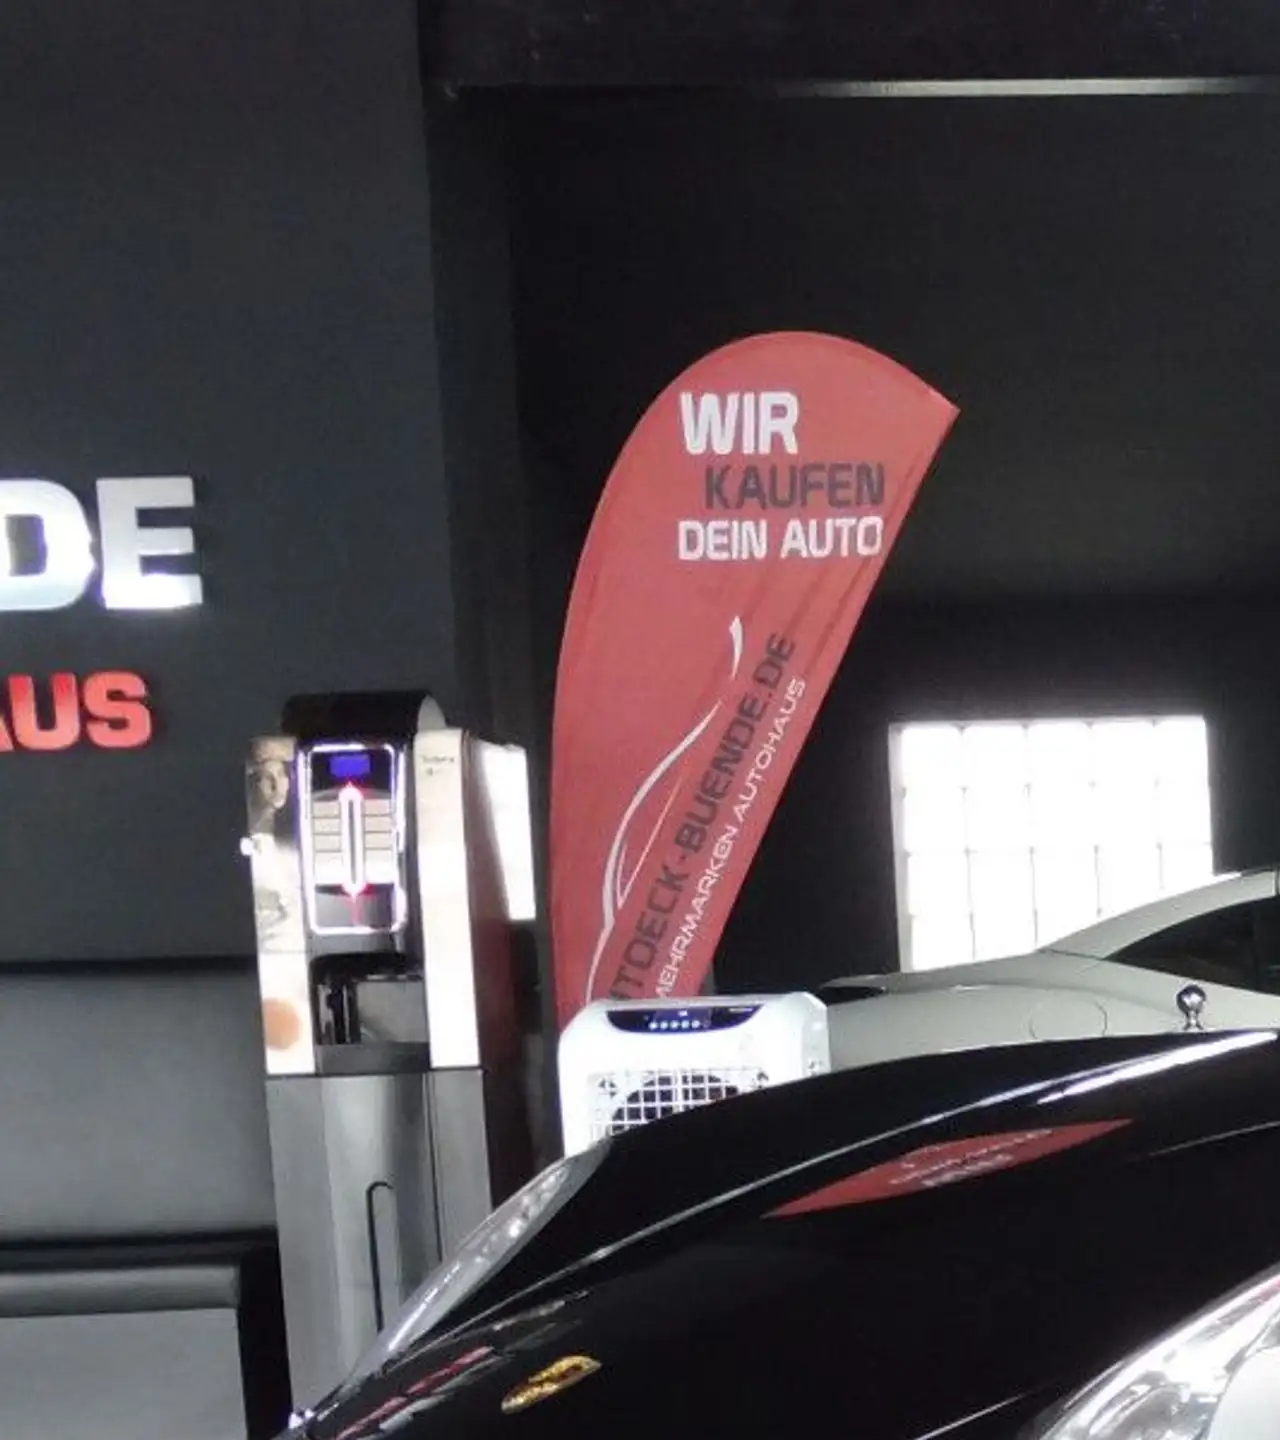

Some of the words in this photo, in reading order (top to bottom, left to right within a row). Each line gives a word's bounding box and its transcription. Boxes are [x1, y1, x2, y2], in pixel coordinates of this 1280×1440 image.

[680, 390, 799, 456] WIR
[704, 462, 886, 511] KAUFEN
[678, 518, 768, 561] DEIN
[780, 515, 885, 559] AUTO
[0, 670, 152, 751] US
[732, 674, 806, 823] AUTOHAUS
